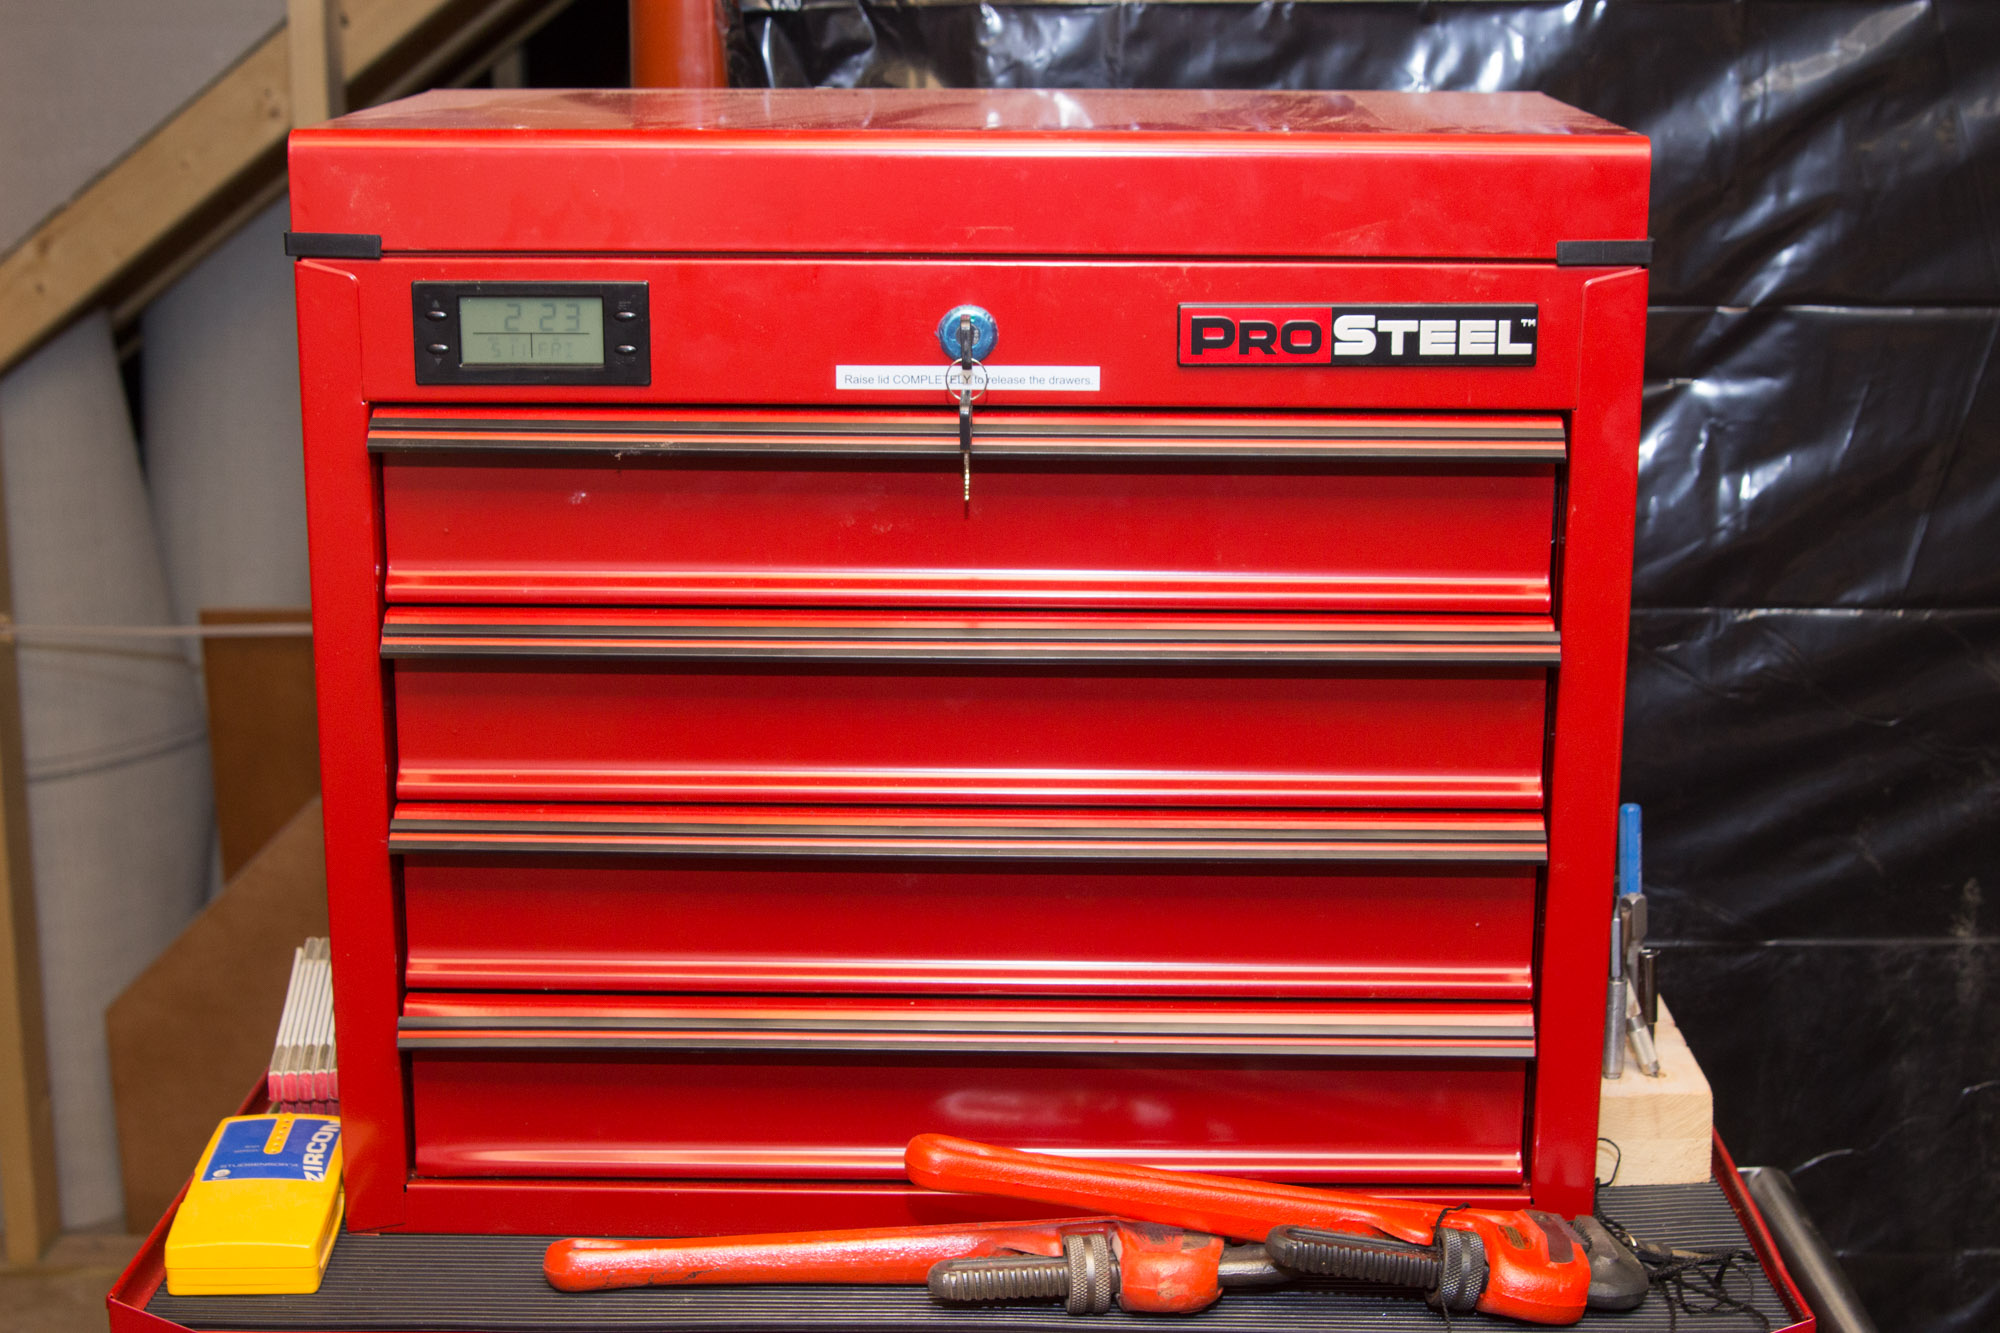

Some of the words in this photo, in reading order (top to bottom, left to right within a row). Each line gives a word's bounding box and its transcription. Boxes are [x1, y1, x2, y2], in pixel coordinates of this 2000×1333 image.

[844, 374, 874, 385] Raise
[878, 374, 890, 385] lid
[974, 375, 985, 385] to
[1029, 375, 1045, 385] the
[1048, 375, 1094, 385] drawers.
[302, 1119, 341, 1182] ZIRCON
